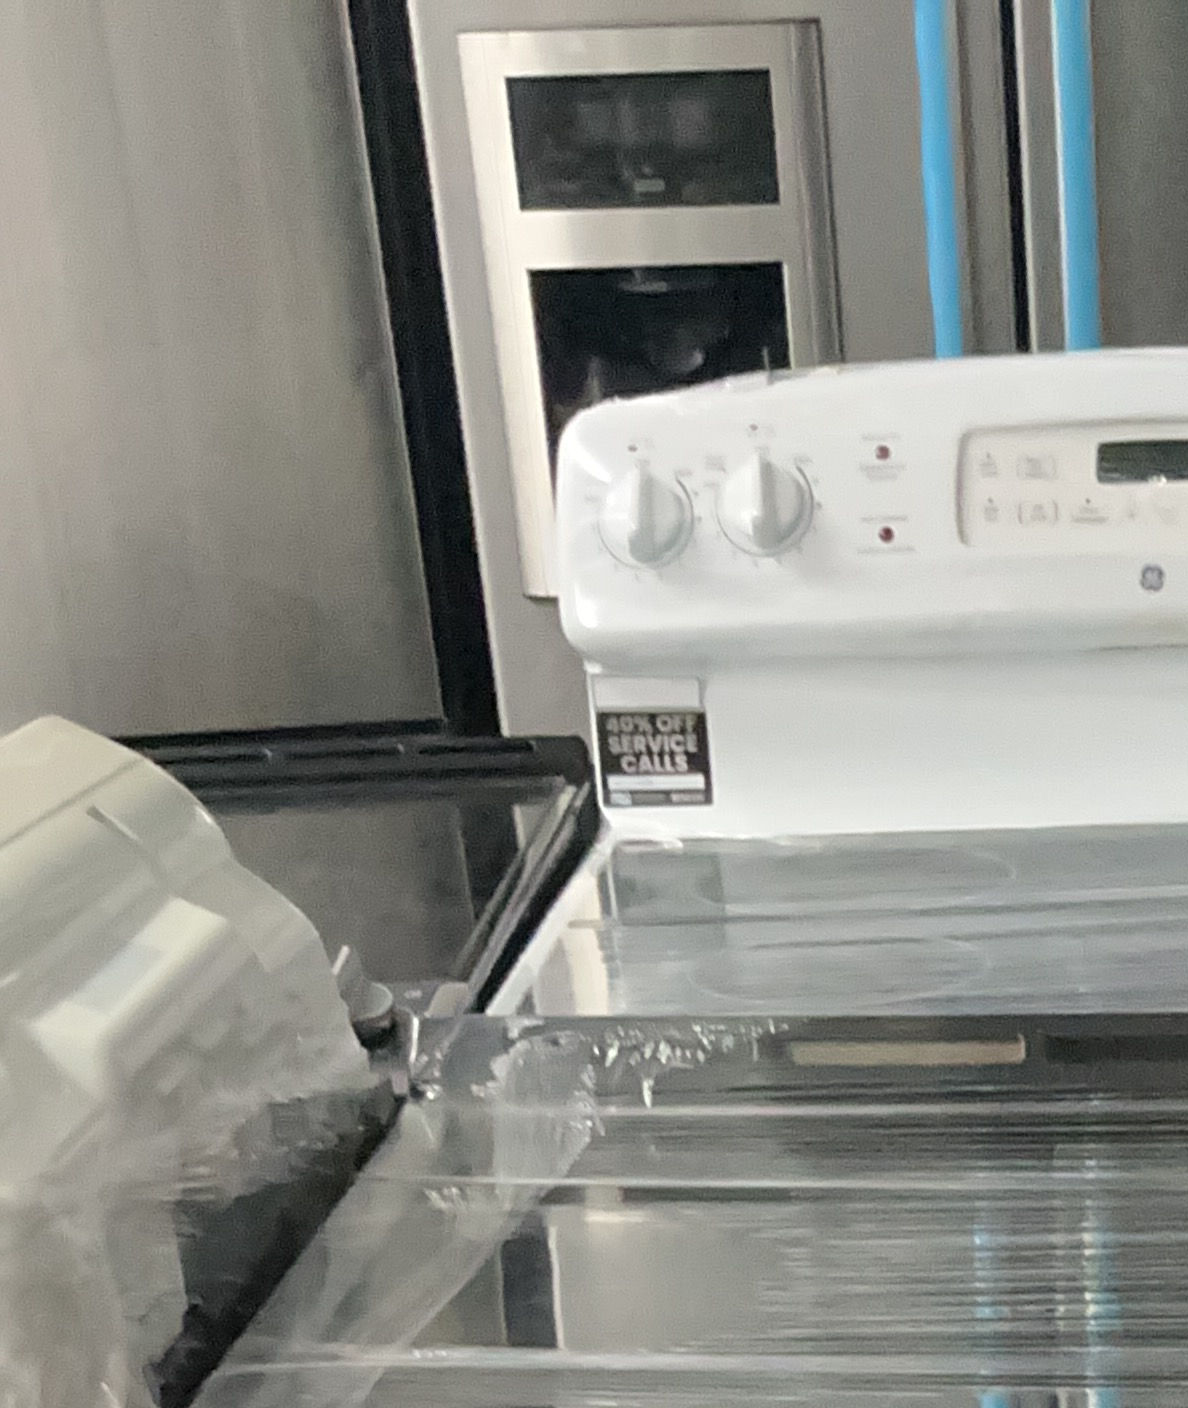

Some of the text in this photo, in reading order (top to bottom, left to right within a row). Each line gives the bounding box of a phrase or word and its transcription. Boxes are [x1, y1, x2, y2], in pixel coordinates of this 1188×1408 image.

[656, 713, 698, 732] OFF
[608, 734, 698, 753] SERVICE
[621, 755, 688, 773] CALLS
